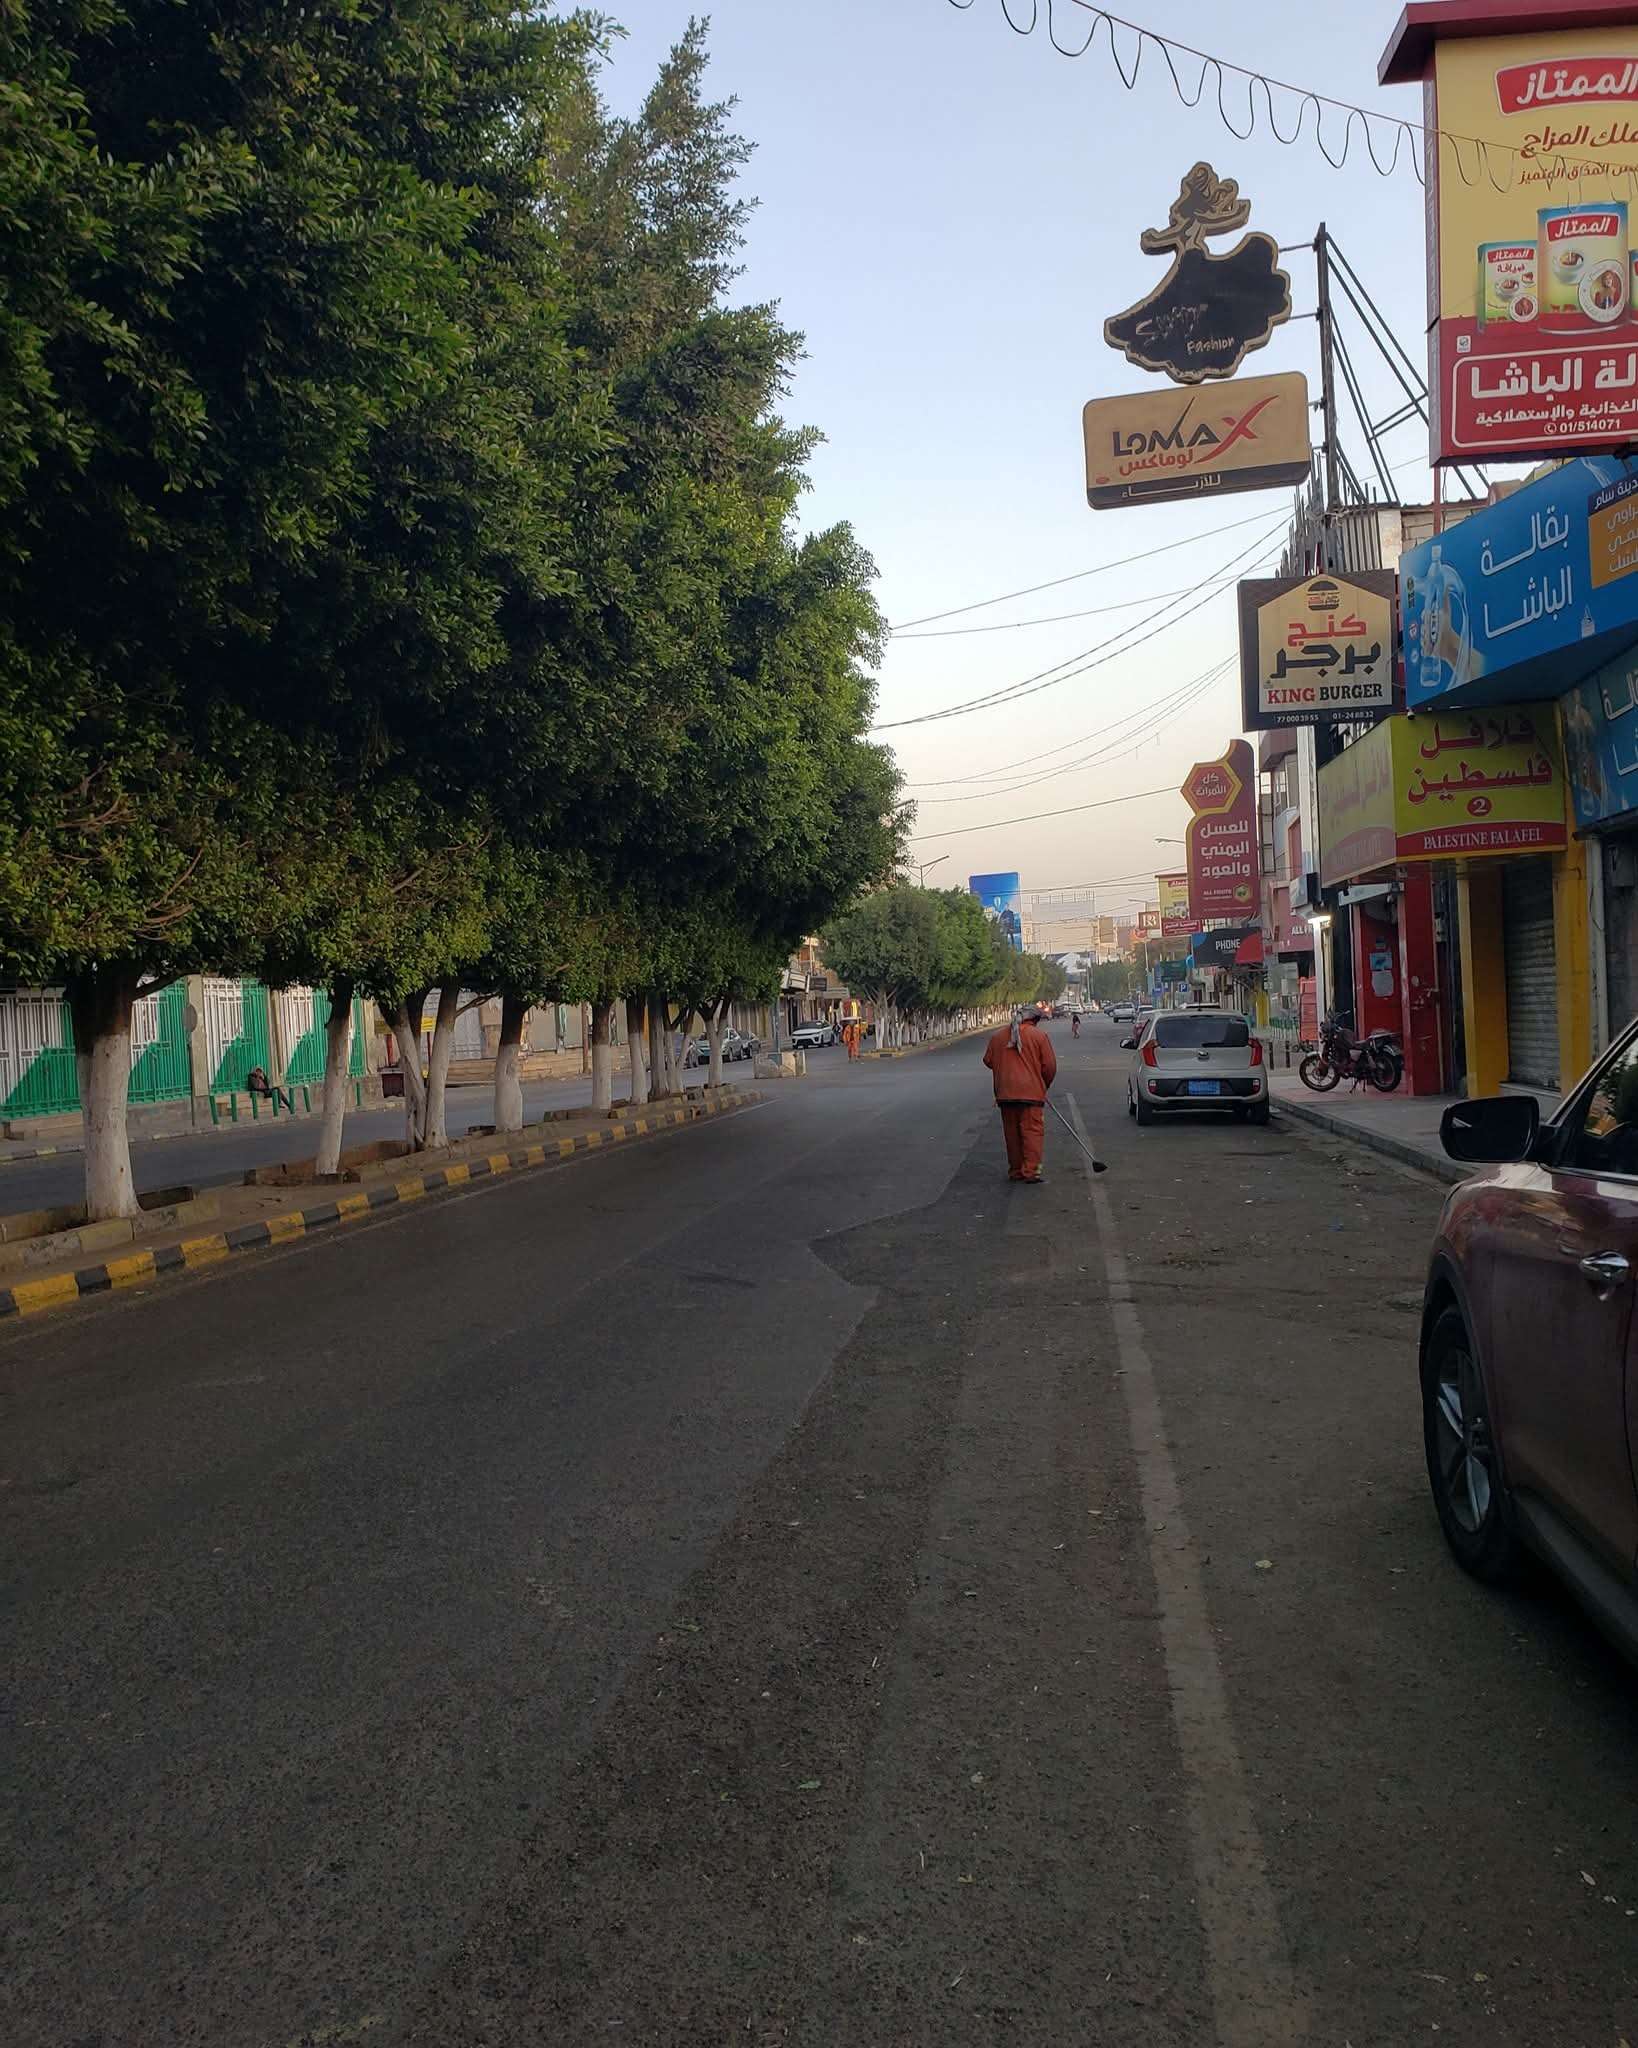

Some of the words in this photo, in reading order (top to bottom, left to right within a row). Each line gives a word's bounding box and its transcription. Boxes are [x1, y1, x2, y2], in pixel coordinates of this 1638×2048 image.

[1516, 62, 1638, 105] الممتاز
[1521, 125, 1589, 158] المزاج
[1471, 357, 1583, 401] الباشا
[1112, 395, 1280, 464] LOMAX
[1559, 418, 1621, 433] 01/514071
[1119, 449, 1194, 476] لوماكس
[1484, 565, 1573, 640] الباشا
[1287, 613, 1367, 647] كنج
[1269, 641, 1382, 679] برجر
[1267, 687, 1316, 704] KING
[1319, 683, 1383, 701] BURGER
[1202, 773, 1220, 785] كل
[1407, 752, 1553, 806] فلسطين
[1472, 799, 1489, 814] 2
[1200, 820, 1249, 838] للعسل
[1201, 840, 1249, 859] اليمني
[1423, 831, 1489, 850] PALESTINE
[1201, 861, 1251, 879] والعود
[1215, 938, 1241, 951] PHONE
[1180, 984, 1187, 993] P
